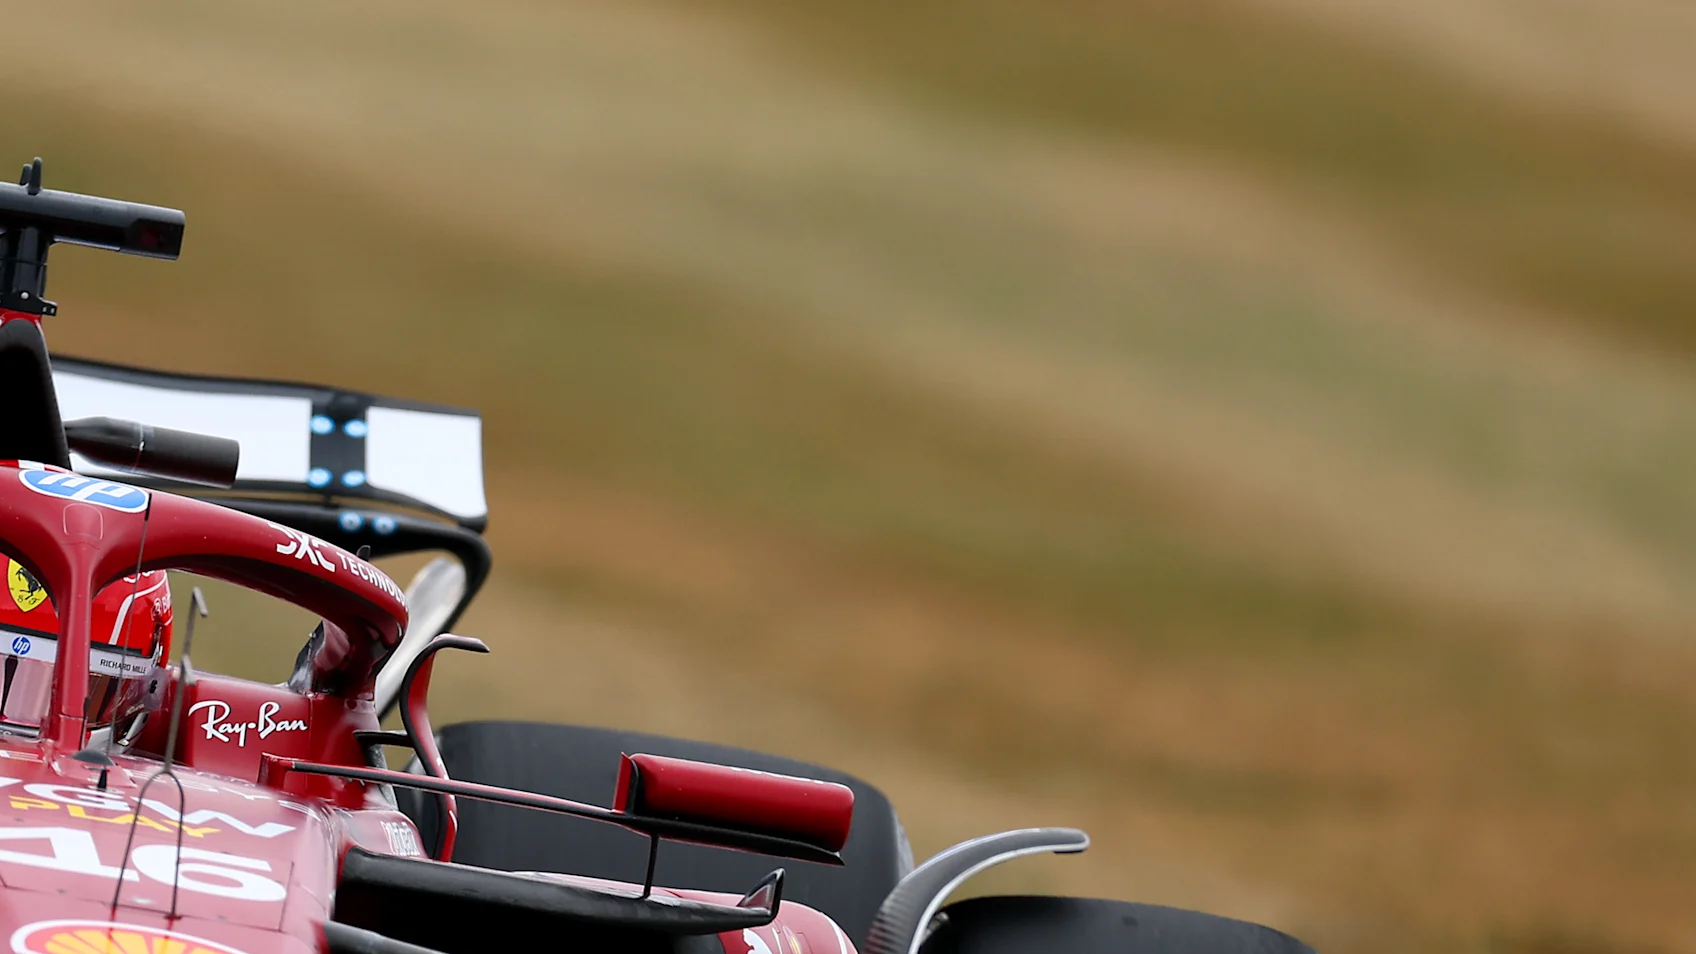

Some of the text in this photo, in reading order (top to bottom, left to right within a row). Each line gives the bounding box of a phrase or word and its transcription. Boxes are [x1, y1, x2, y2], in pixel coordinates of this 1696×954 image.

[13, 637, 31, 655] hp
[99, 658, 148, 675] RICHARD MILLE
[8, 795, 222, 838] PLAY
